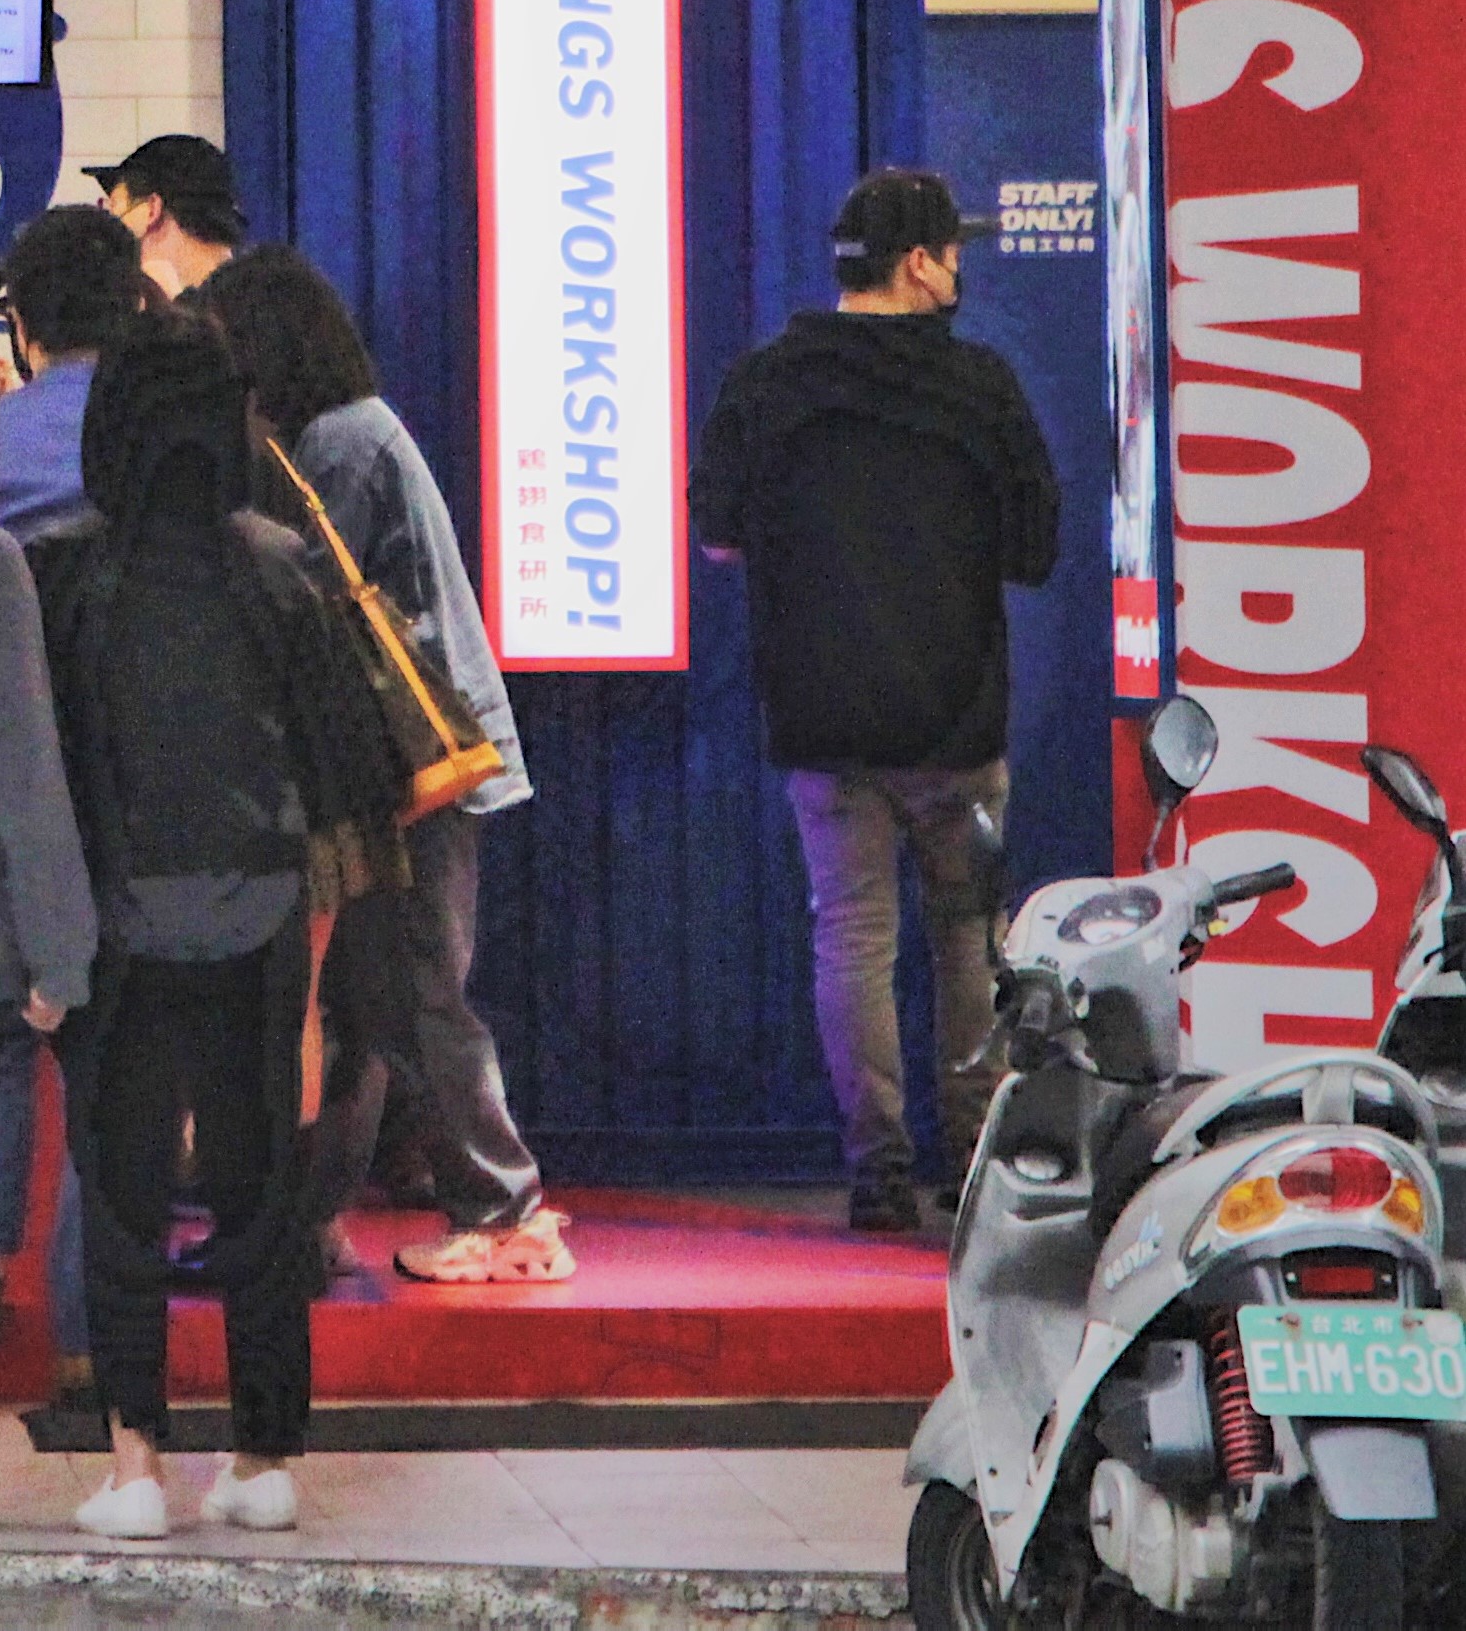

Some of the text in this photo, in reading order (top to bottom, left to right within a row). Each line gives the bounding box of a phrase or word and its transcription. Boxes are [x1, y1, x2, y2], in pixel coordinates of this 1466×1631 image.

[998, 182, 1099, 205] STAFF
[1000, 209, 1095, 232] ONLY!
[560, 150, 624, 632] WORKSHOP!
[1310, 1313, 1395, 1335] 台北市
[1249, 1338, 1466, 1400] EHM-630
